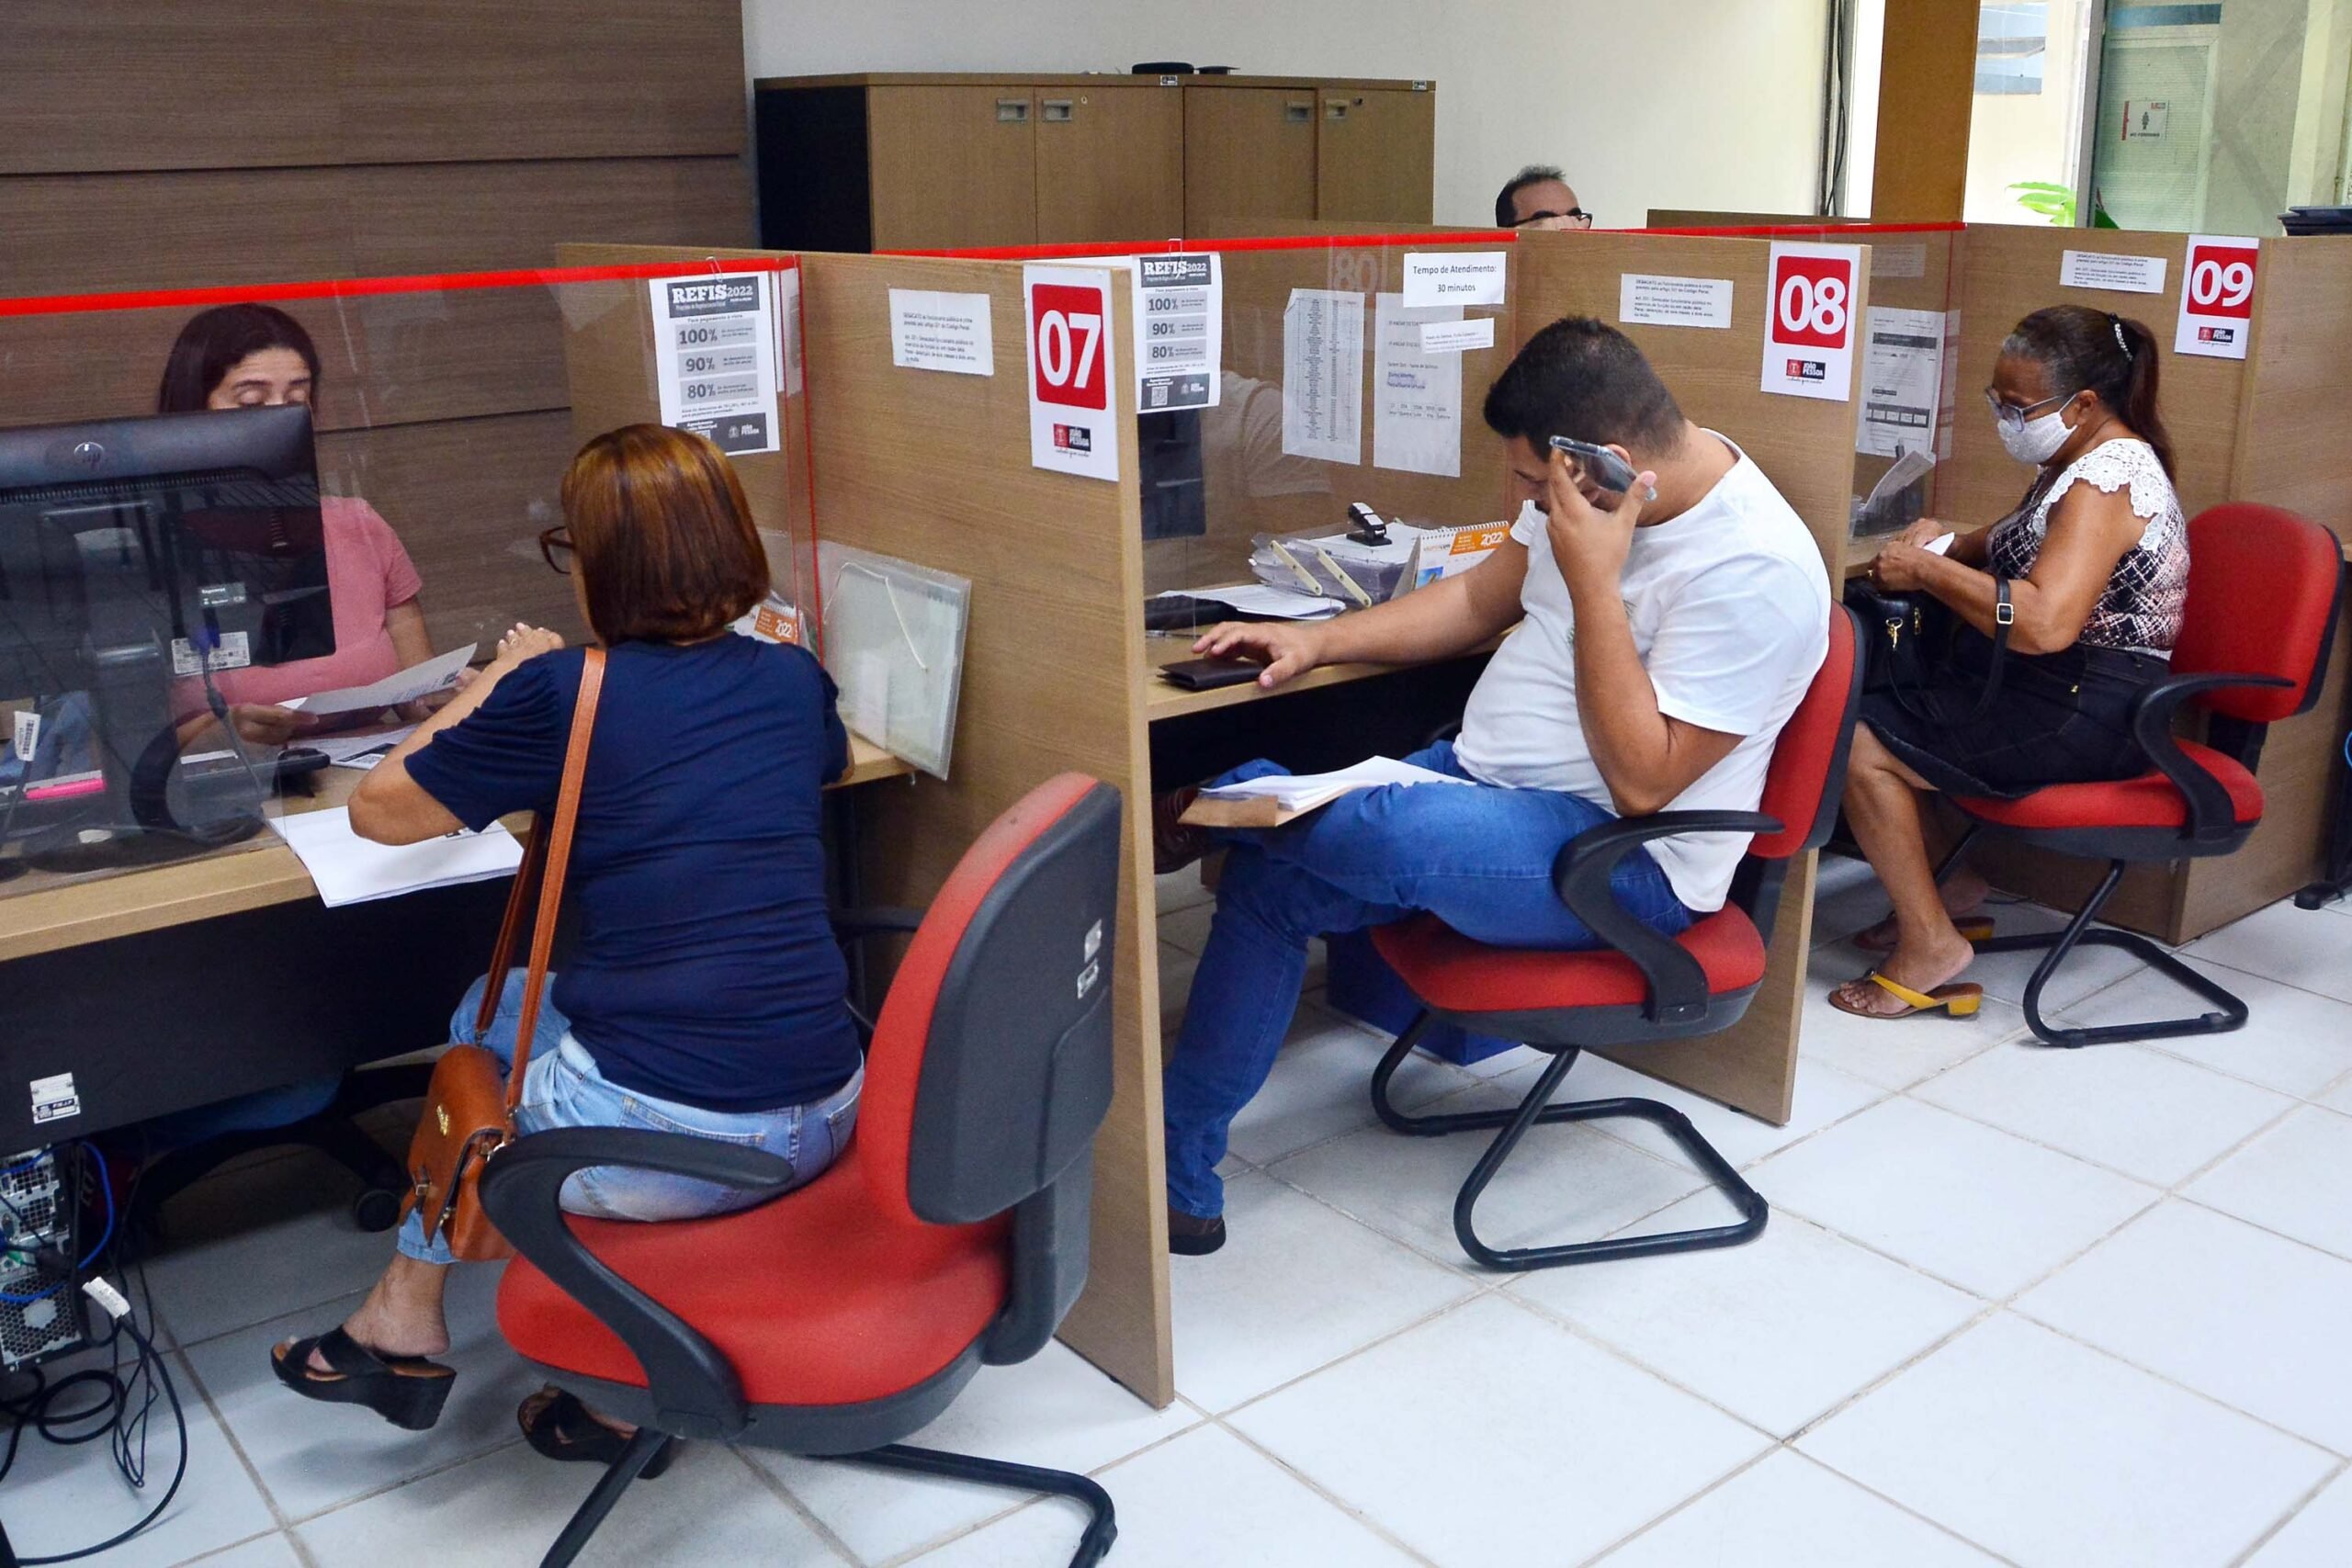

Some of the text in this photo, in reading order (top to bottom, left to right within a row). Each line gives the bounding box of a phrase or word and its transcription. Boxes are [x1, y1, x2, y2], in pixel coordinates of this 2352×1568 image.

[1144, 261, 1207, 275] REFIS 2022
[1413, 265, 1497, 275] Tempo de Atendimento:
[1437, 283, 1476, 292] 30 minutos
[2191, 260, 2254, 307] 09
[672, 284, 753, 304] REFIS 2022
[1148, 298, 1178, 311] 100%
[1780, 275, 1846, 334] 08
[679, 328, 718, 344] 100%
[1152, 322, 1176, 335] 90%
[1038, 310, 1102, 389] 07
[1152, 346, 1174, 358] 80%
[685, 356, 716, 372] 90%
[687, 384, 716, 399] 80%
[1480, 531, 1504, 546] 2022
